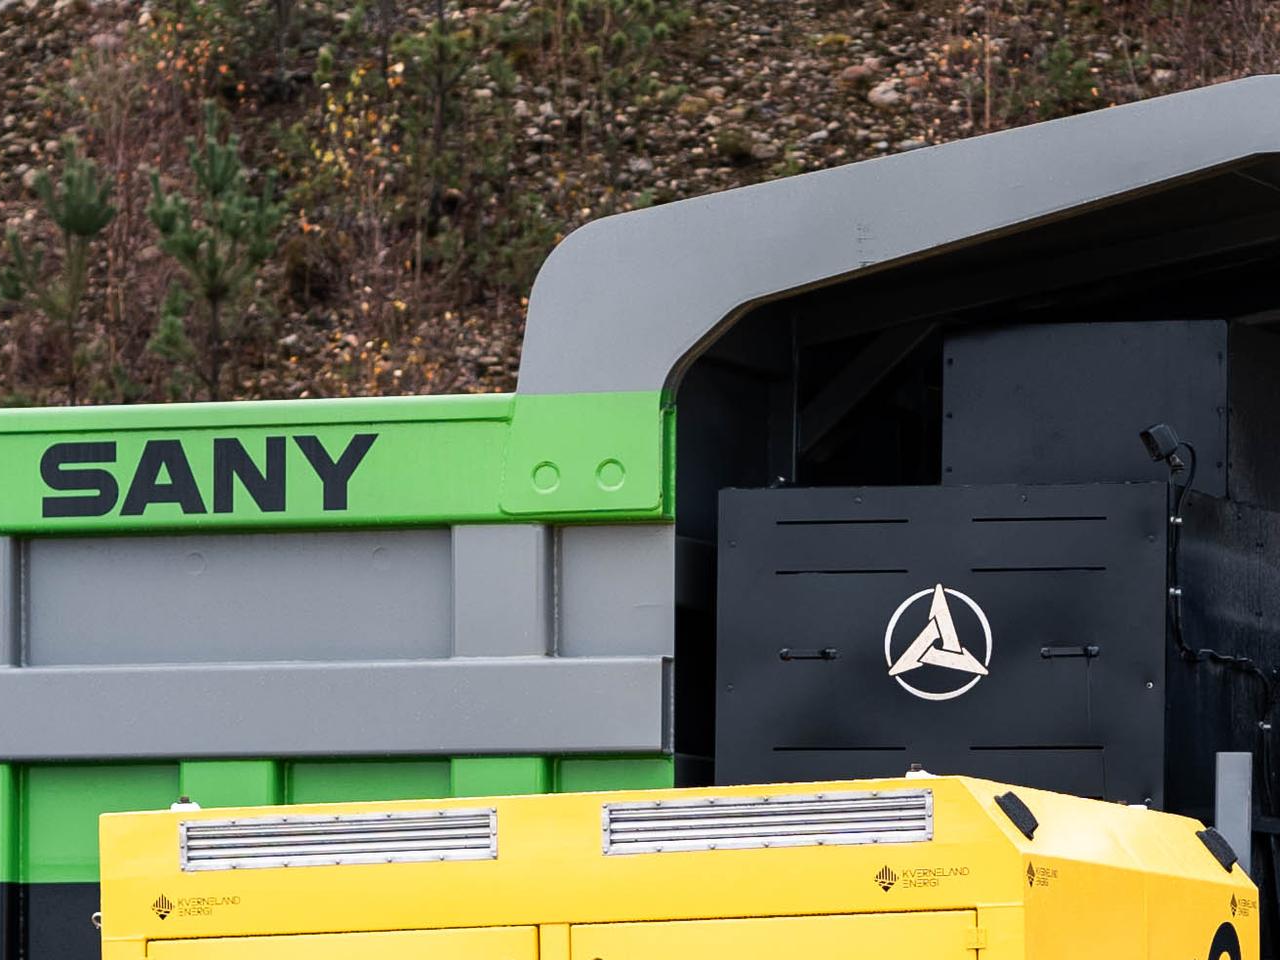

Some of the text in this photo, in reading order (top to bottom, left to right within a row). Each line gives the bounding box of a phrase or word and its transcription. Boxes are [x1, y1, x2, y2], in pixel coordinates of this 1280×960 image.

[39, 433, 379, 518] SANY
[901, 867, 970, 879] KVERNELAND
[902, 879, 940, 889] ENERGI
[177, 895, 241, 906] KVERNELAND
[178, 906, 213, 917] ENERGI
